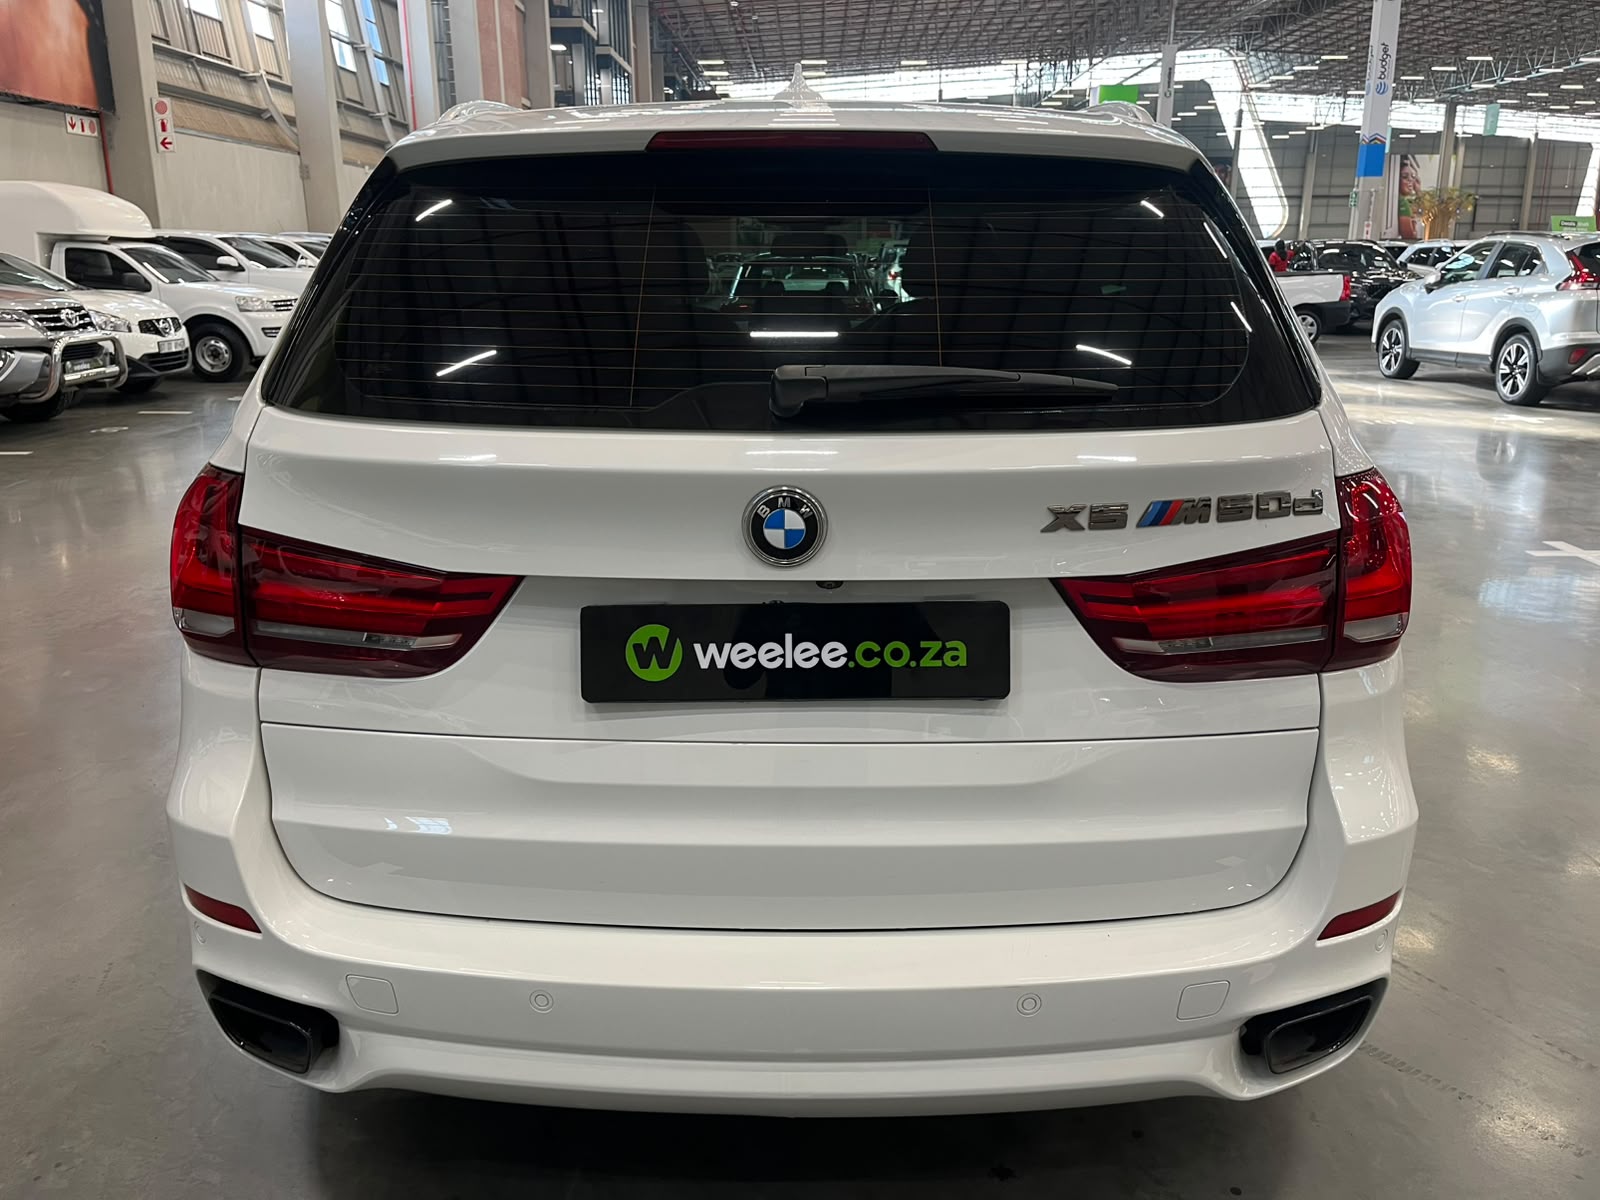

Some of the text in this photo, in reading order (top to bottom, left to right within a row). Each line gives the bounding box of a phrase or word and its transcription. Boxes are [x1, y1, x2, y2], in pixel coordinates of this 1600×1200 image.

[1377, 42, 1391, 80] budget
[757, 497, 813, 518] BMW
[1040, 504, 1129, 533] X5
[693, 632, 968, 670] weelee.co.za
